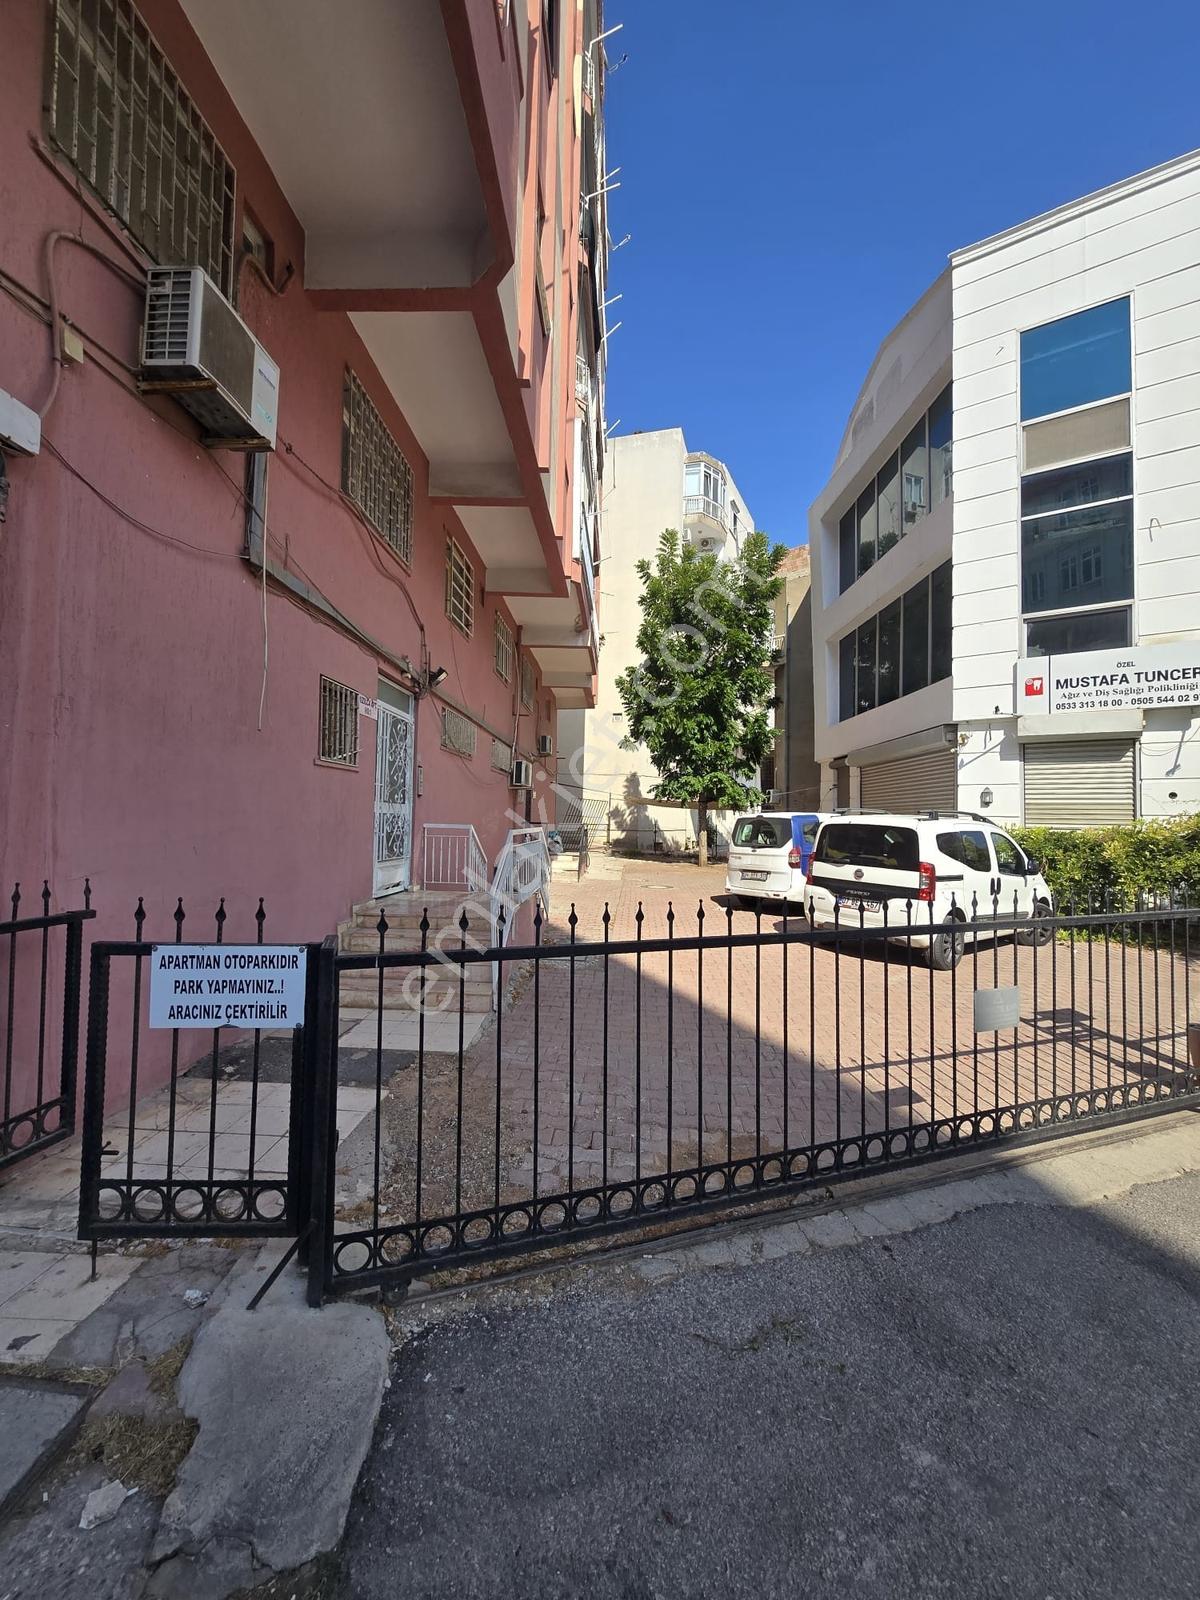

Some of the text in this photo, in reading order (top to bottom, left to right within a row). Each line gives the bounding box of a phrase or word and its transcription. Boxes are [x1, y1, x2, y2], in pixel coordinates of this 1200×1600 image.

[1116, 660, 1136, 668] ÖZEL
[1055, 673, 1130, 690] MUSTAFA
[1061, 692, 1081, 700] Ağız
[1095, 689, 1110, 697] Diş
[1112, 687, 1144, 696] Sağlığı
[1147, 682, 1199, 693] Polikliniği
[1055, 702, 1077, 710] 0533
[1079, 700, 1096, 709] 313
[1098, 699, 1109, 707] 18
[1111, 699, 1123, 707] 00
[1131, 696, 1154, 705] 0505
[1156, 695, 1175, 704] 544
[1178, 694, 1190, 703] 02
[1193, 693, 1200, 702] 9
[159, 954, 299, 970] APARTMAN OTOPARKIDIR
[174, 979, 285, 995] PARK YAPMAYINIZ..!
[168, 1000, 288, 1023] ARACINIZ ÇEKTİRİLİR
